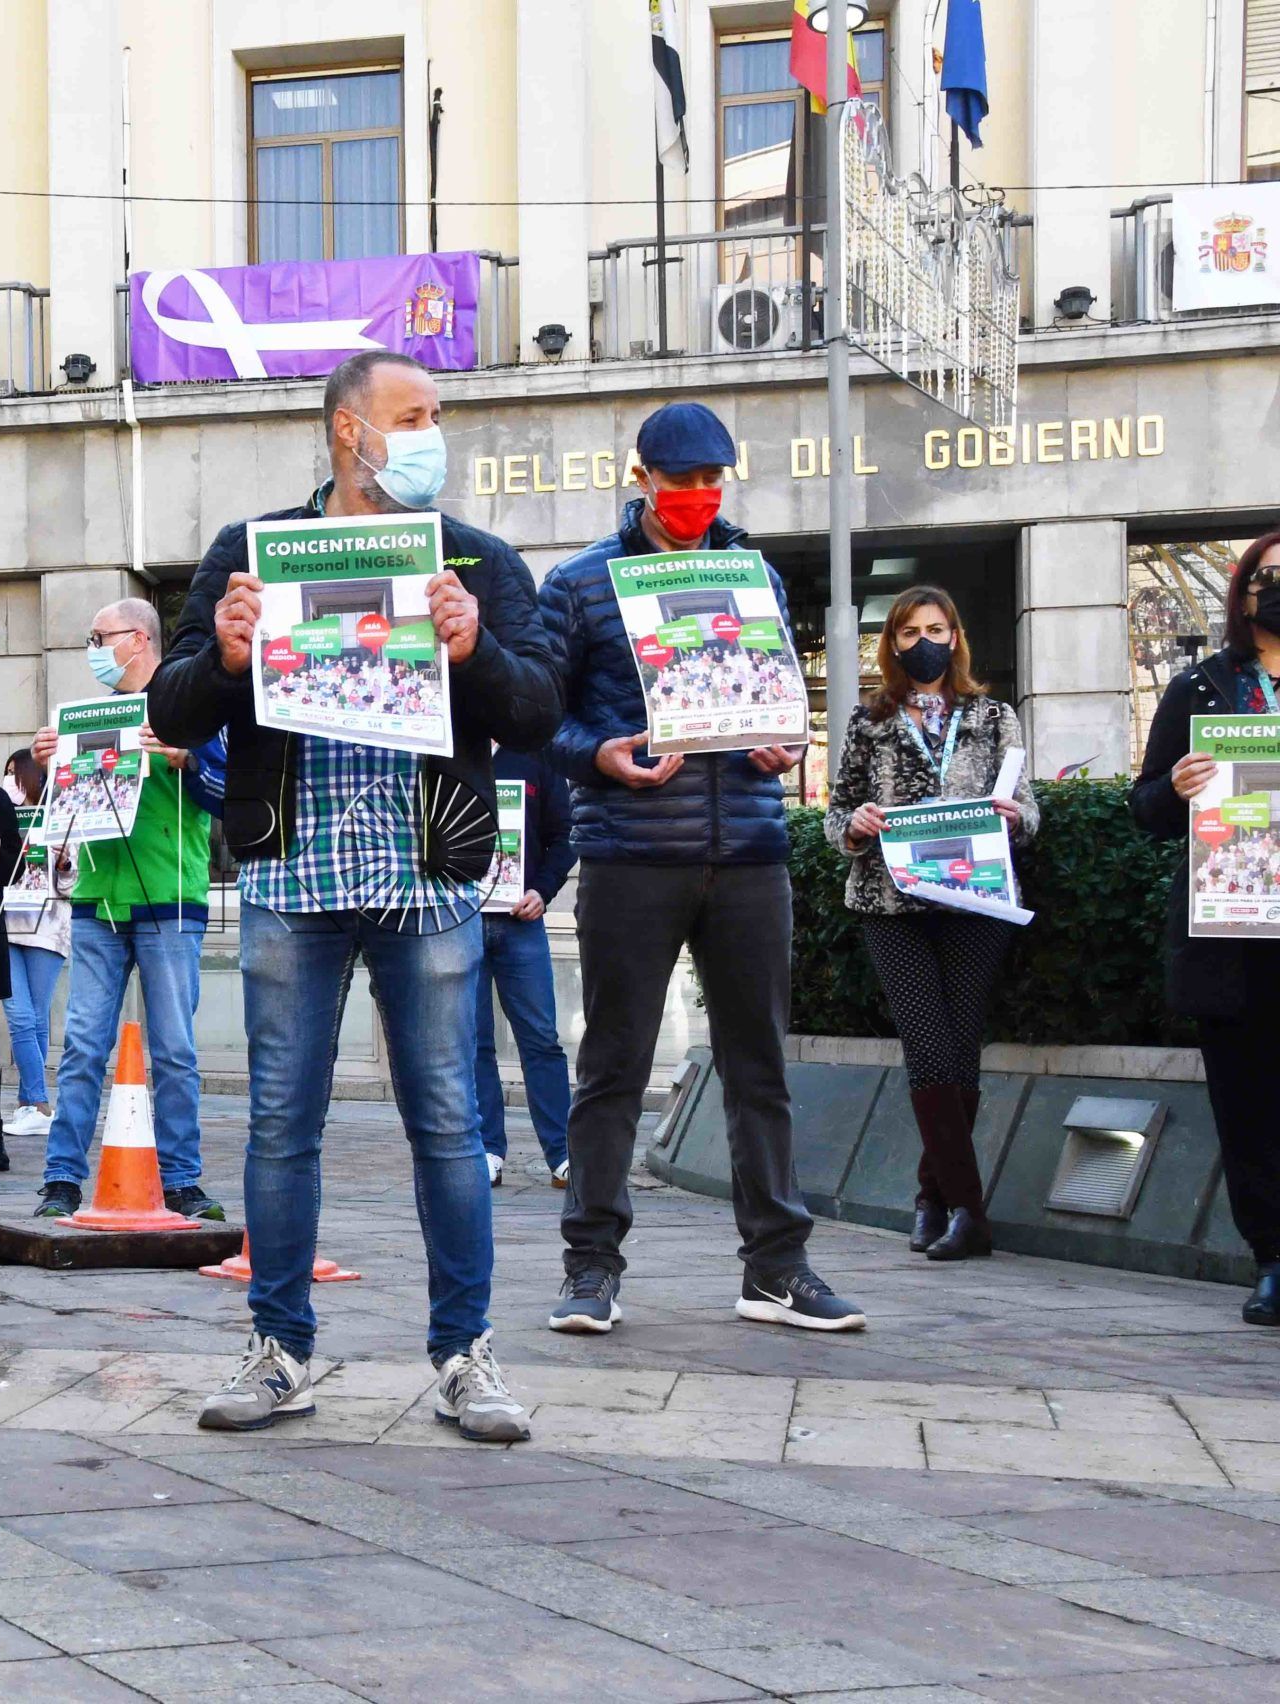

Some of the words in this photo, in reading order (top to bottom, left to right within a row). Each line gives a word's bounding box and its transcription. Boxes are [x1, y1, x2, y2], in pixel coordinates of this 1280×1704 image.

[474, 441, 750, 495] DELEGAN
[924, 415, 1164, 470] GOBIERNO
[265, 531, 427, 557] CONCENTRACIÓN
[281, 558, 349, 575] Personal
[355, 553, 416, 571] INGESA
[619, 556, 755, 578] CONCENTRACIÓN
[636, 574, 695, 590] Personal
[699, 572, 750, 584] INGESA
[63, 704, 141, 721] CONCENTRACIÓN
[68, 719, 102, 730] Personal
[103, 716, 134, 727] INGESA
[1201, 725, 1280, 738] CONCEN
[885, 806, 995, 829] CONCENTRACIÓN
[896, 828, 942, 839] Personal
[945, 820, 988, 834] INGESA
